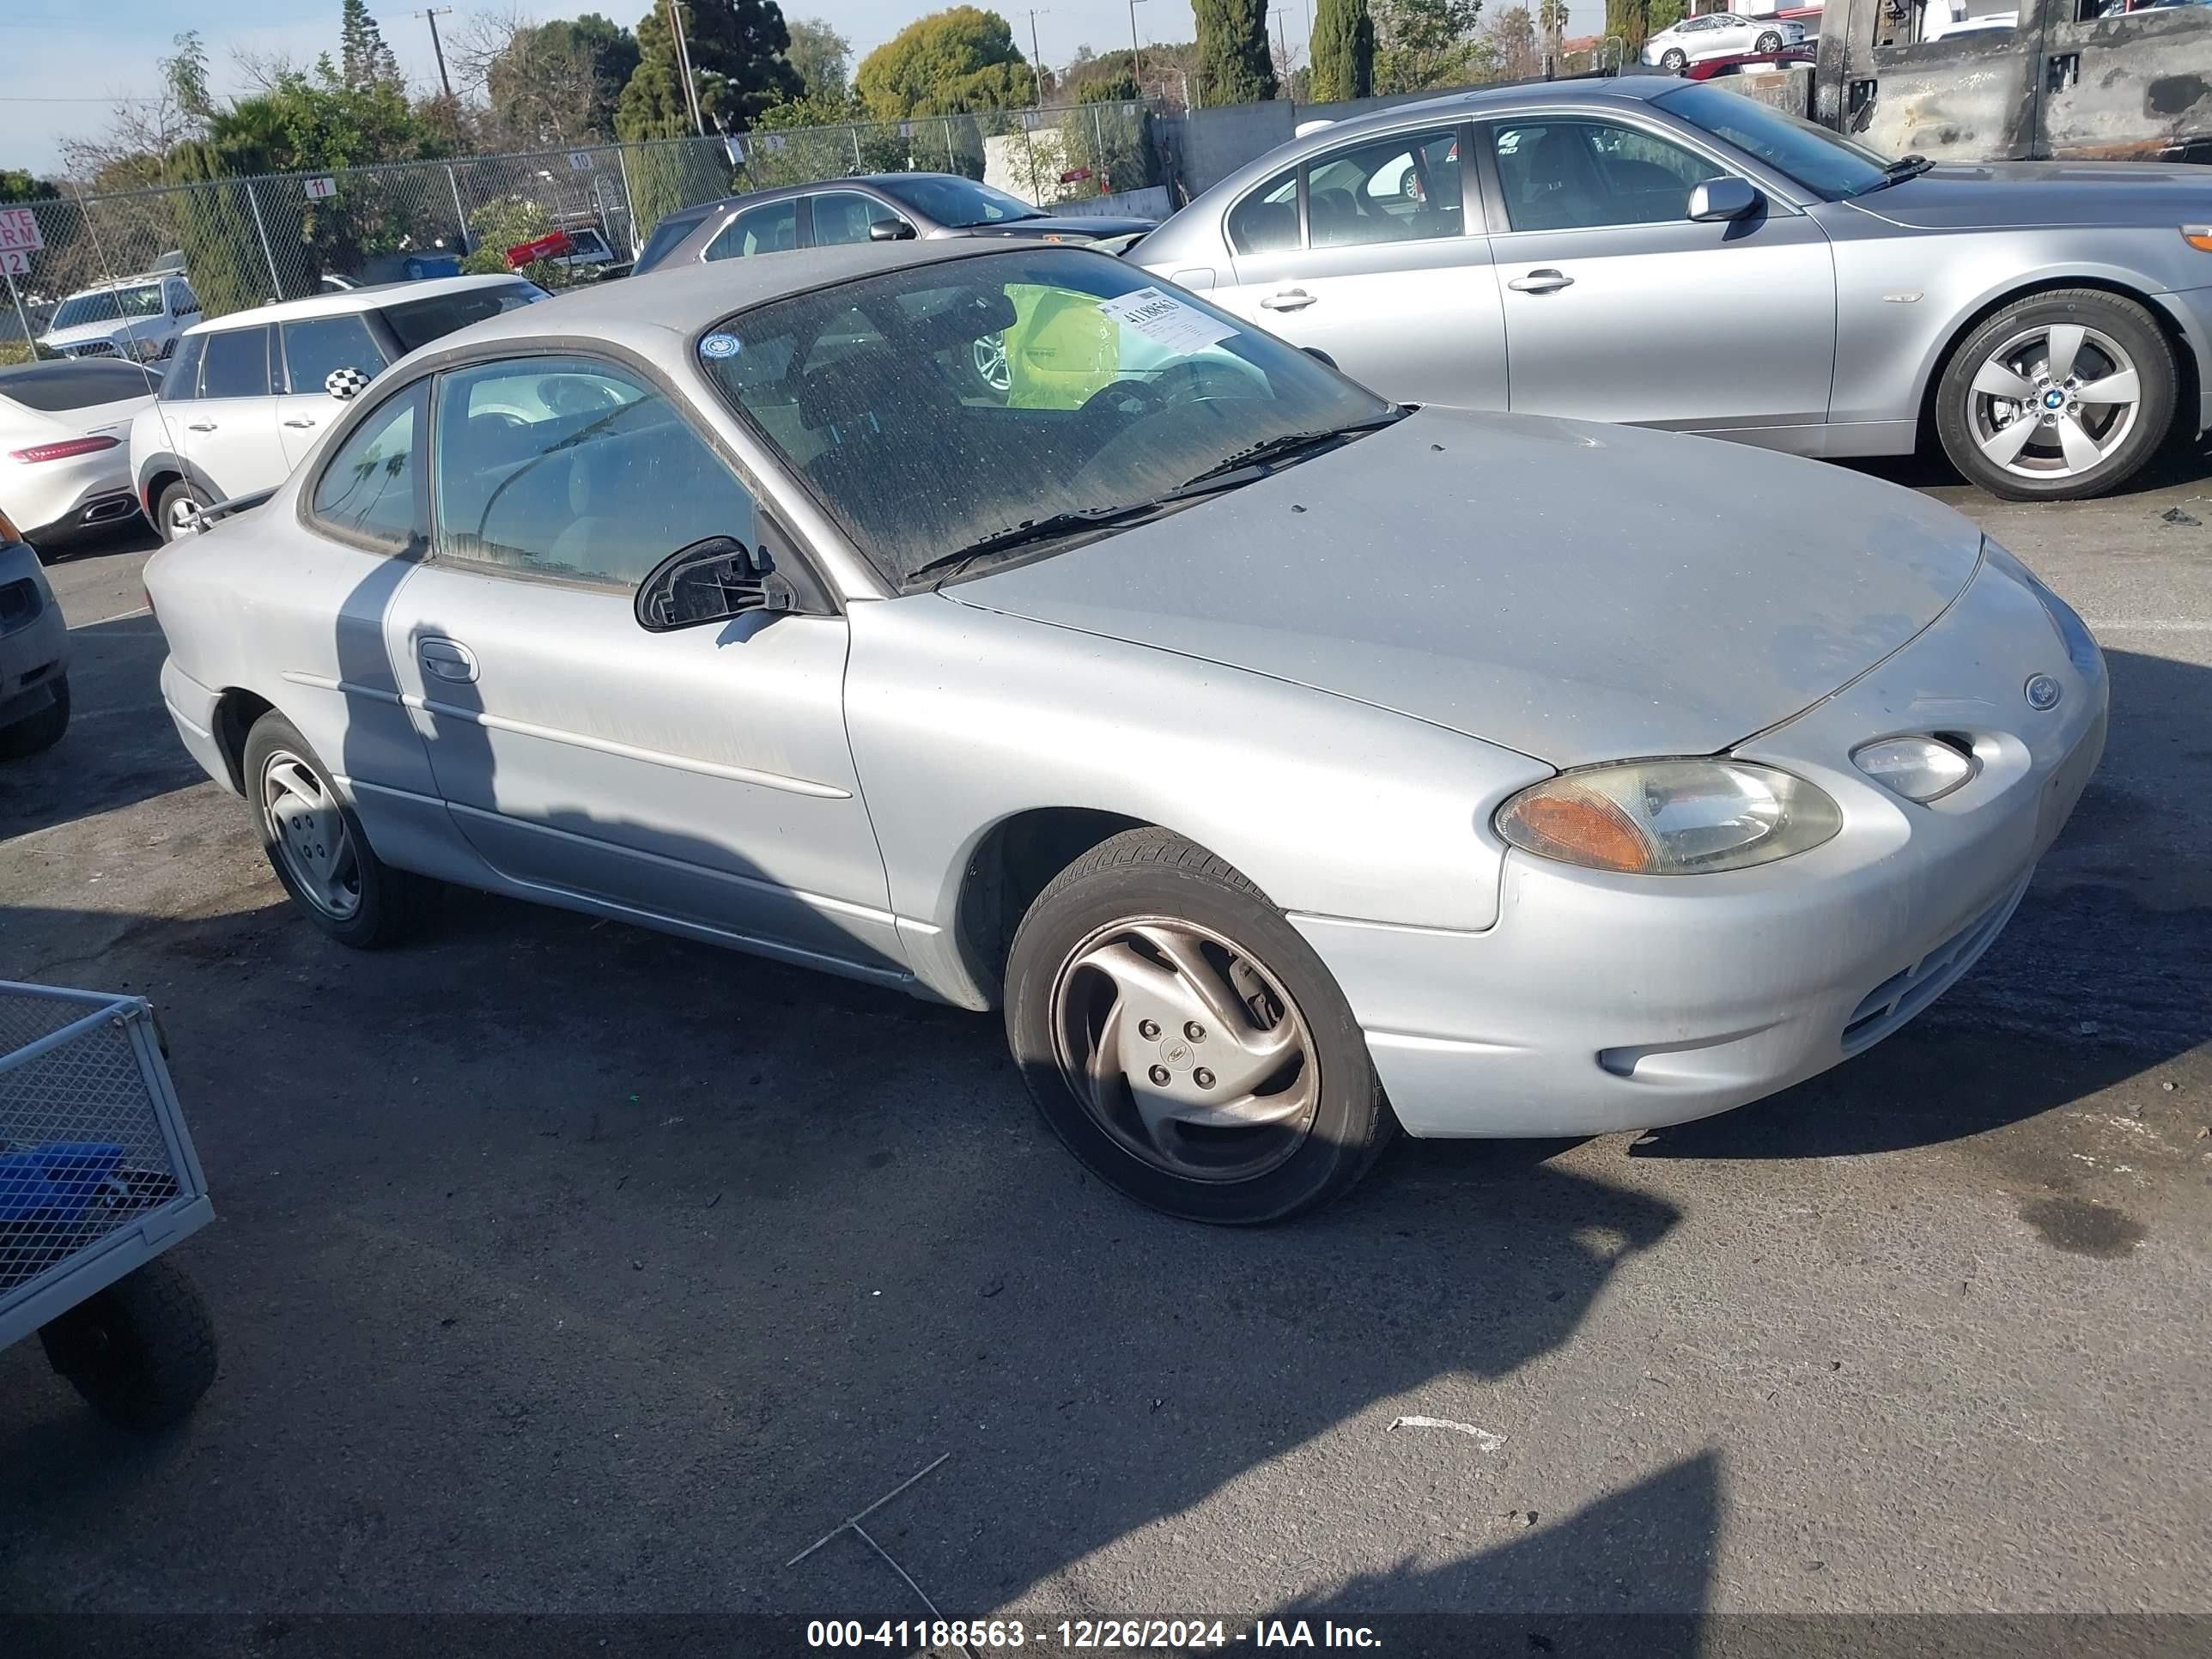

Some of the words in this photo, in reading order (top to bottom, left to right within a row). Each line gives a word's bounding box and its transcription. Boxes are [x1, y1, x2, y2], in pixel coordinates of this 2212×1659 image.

[574, 154, 589, 168] 10
[312, 179, 326, 196] 11
[0, 227, 36, 246] RM
[1123, 299, 1181, 324] 41188563
